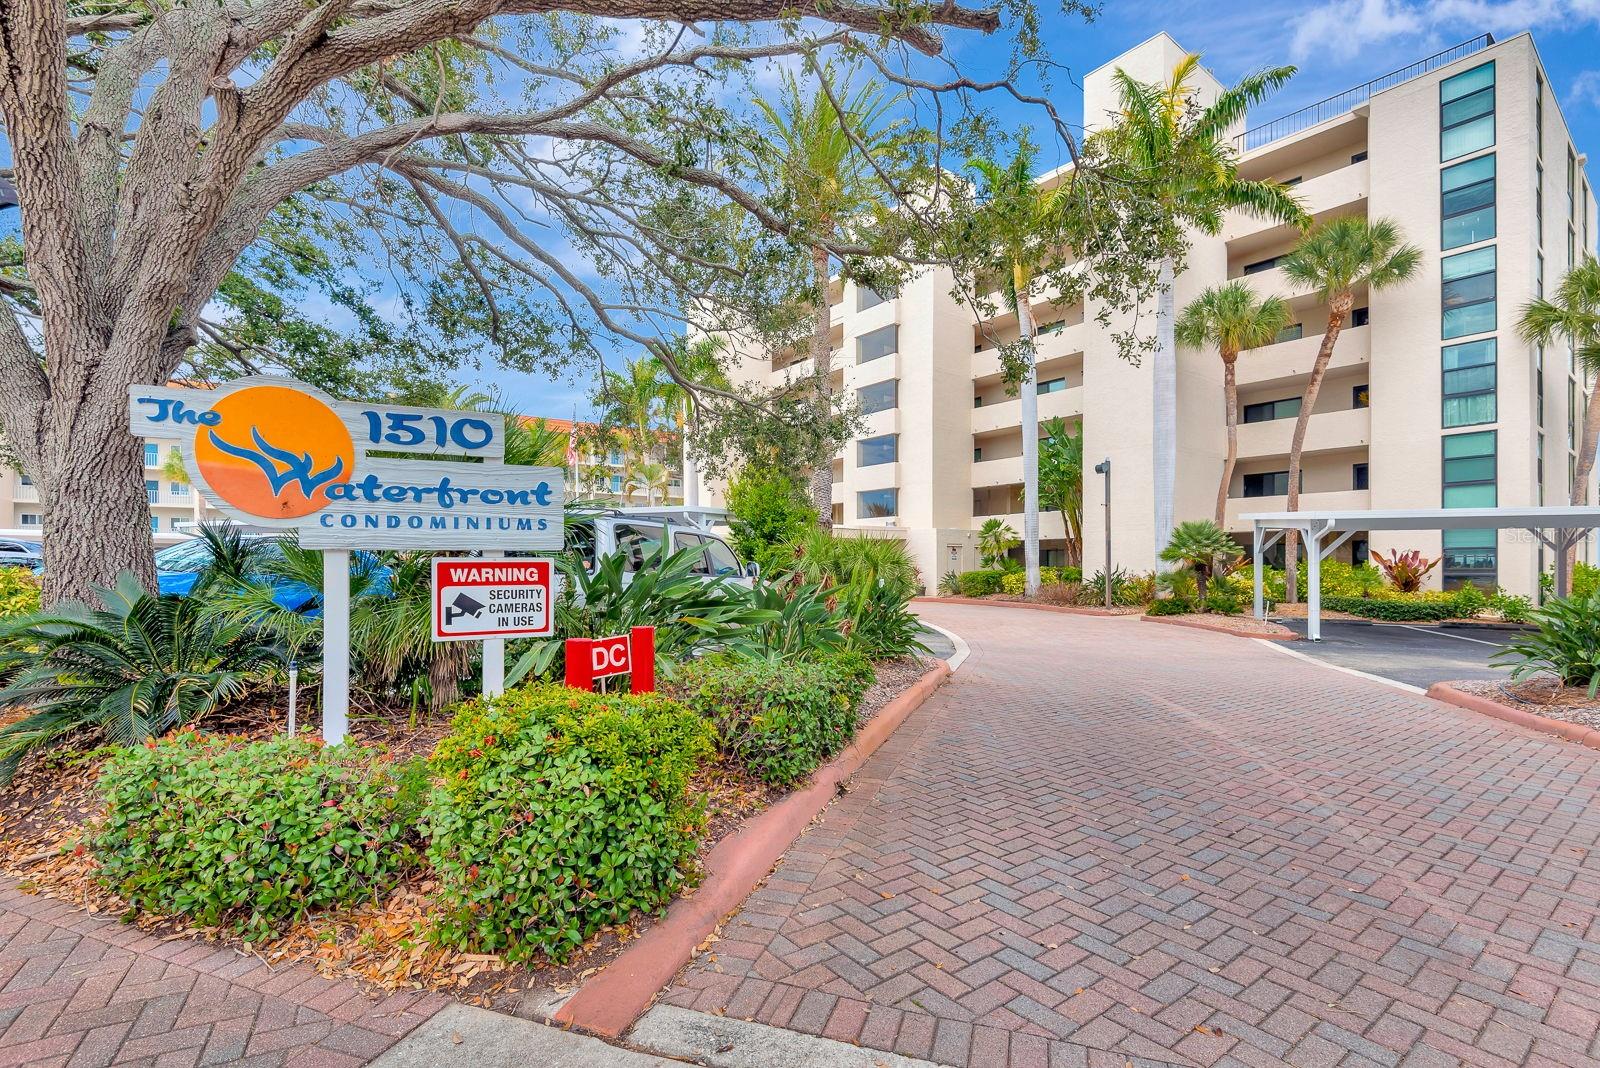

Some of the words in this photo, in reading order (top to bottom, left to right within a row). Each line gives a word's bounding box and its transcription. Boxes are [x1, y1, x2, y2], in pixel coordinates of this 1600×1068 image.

[136, 397, 223, 427] The
[361, 410, 494, 450] 1510
[208, 425, 553, 509] Waterfront
[319, 513, 548, 531] CONDOMINIUMS
[450, 567, 539, 583] WARNING
[489, 588, 543, 601] SECURITY
[488, 602, 543, 614] CAMERAS
[497, 616, 510, 627] IN
[513, 615, 534, 627] USE
[592, 643, 627, 671] DC
